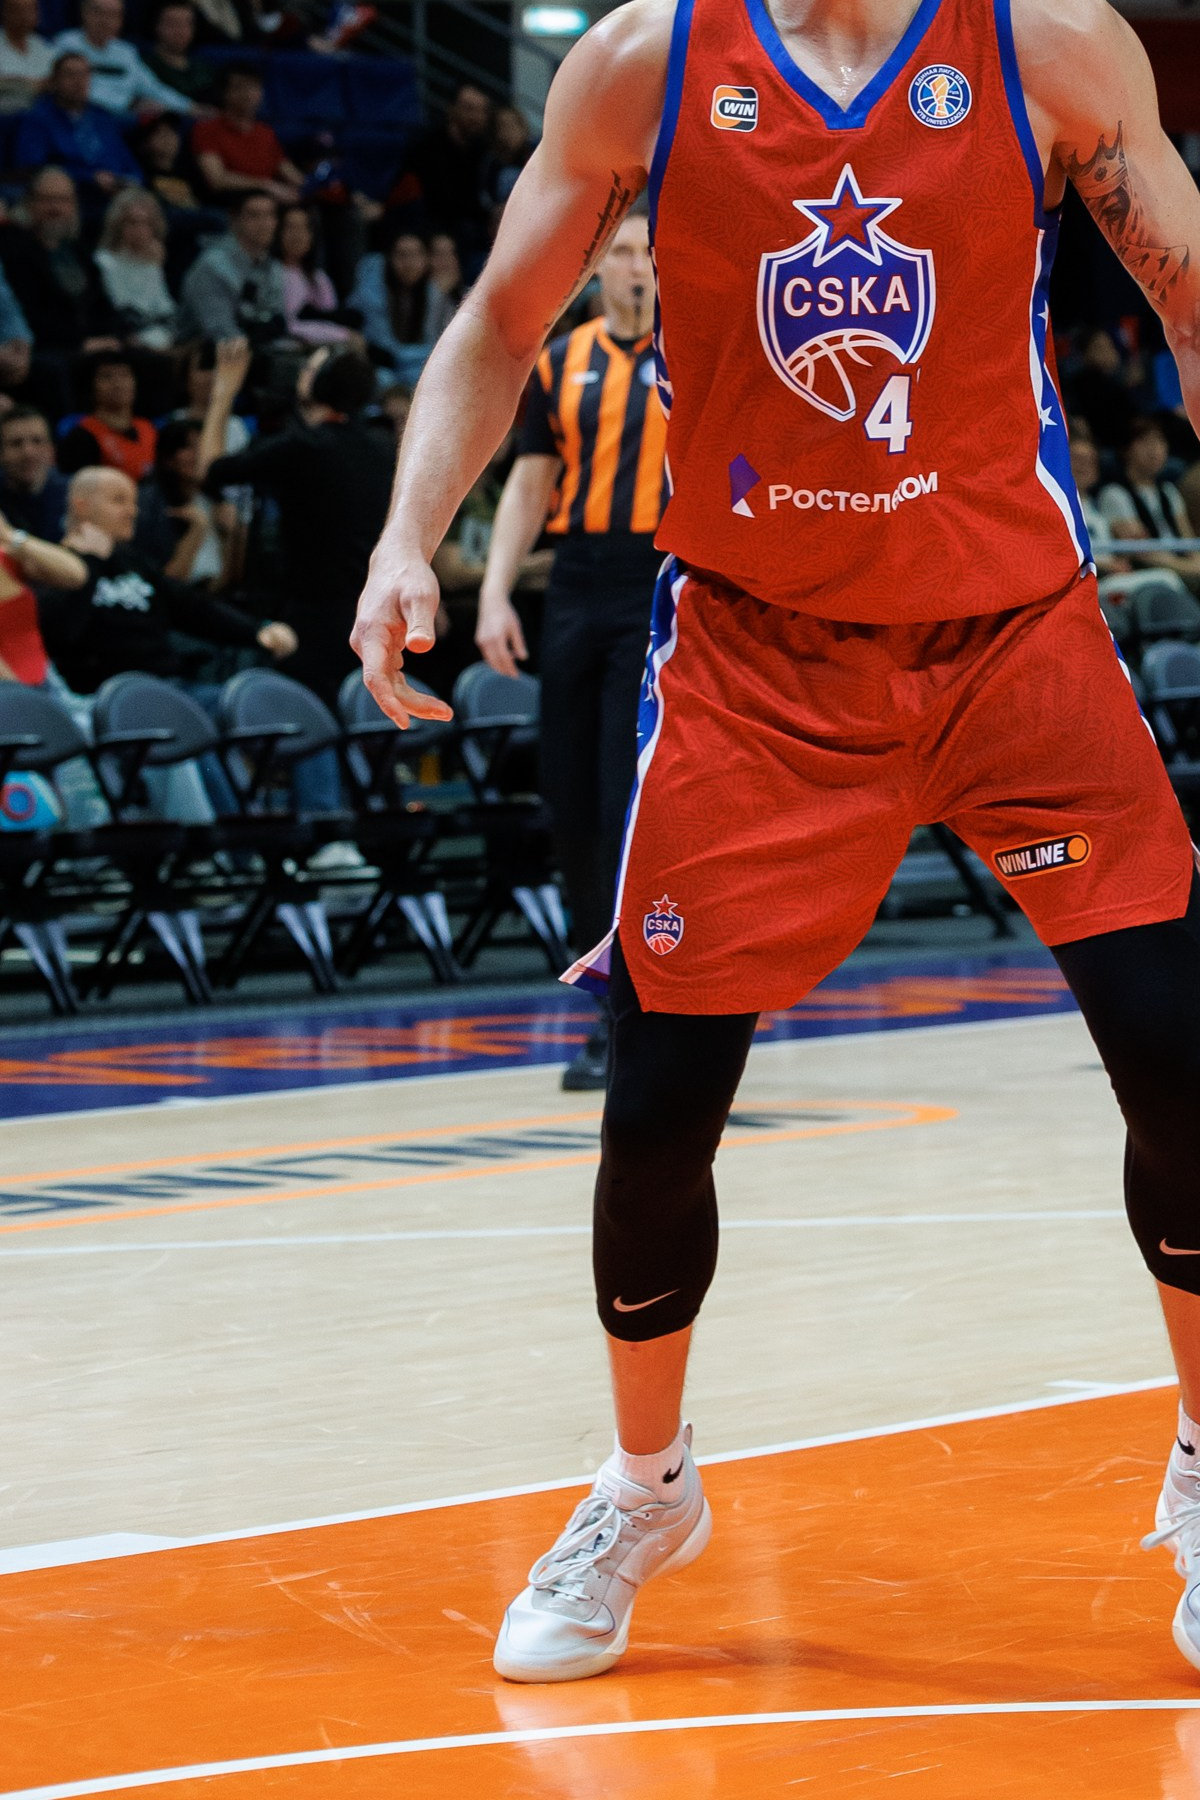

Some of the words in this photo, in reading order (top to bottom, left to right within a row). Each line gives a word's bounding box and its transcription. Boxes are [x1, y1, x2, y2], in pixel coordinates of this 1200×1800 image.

[724, 101, 755, 116] WIN
[783, 276, 911, 317] CSKA
[864, 375, 913, 454] 4
[997, 842, 1065, 874] WINLINE
[647, 918, 680, 931] CSKA
